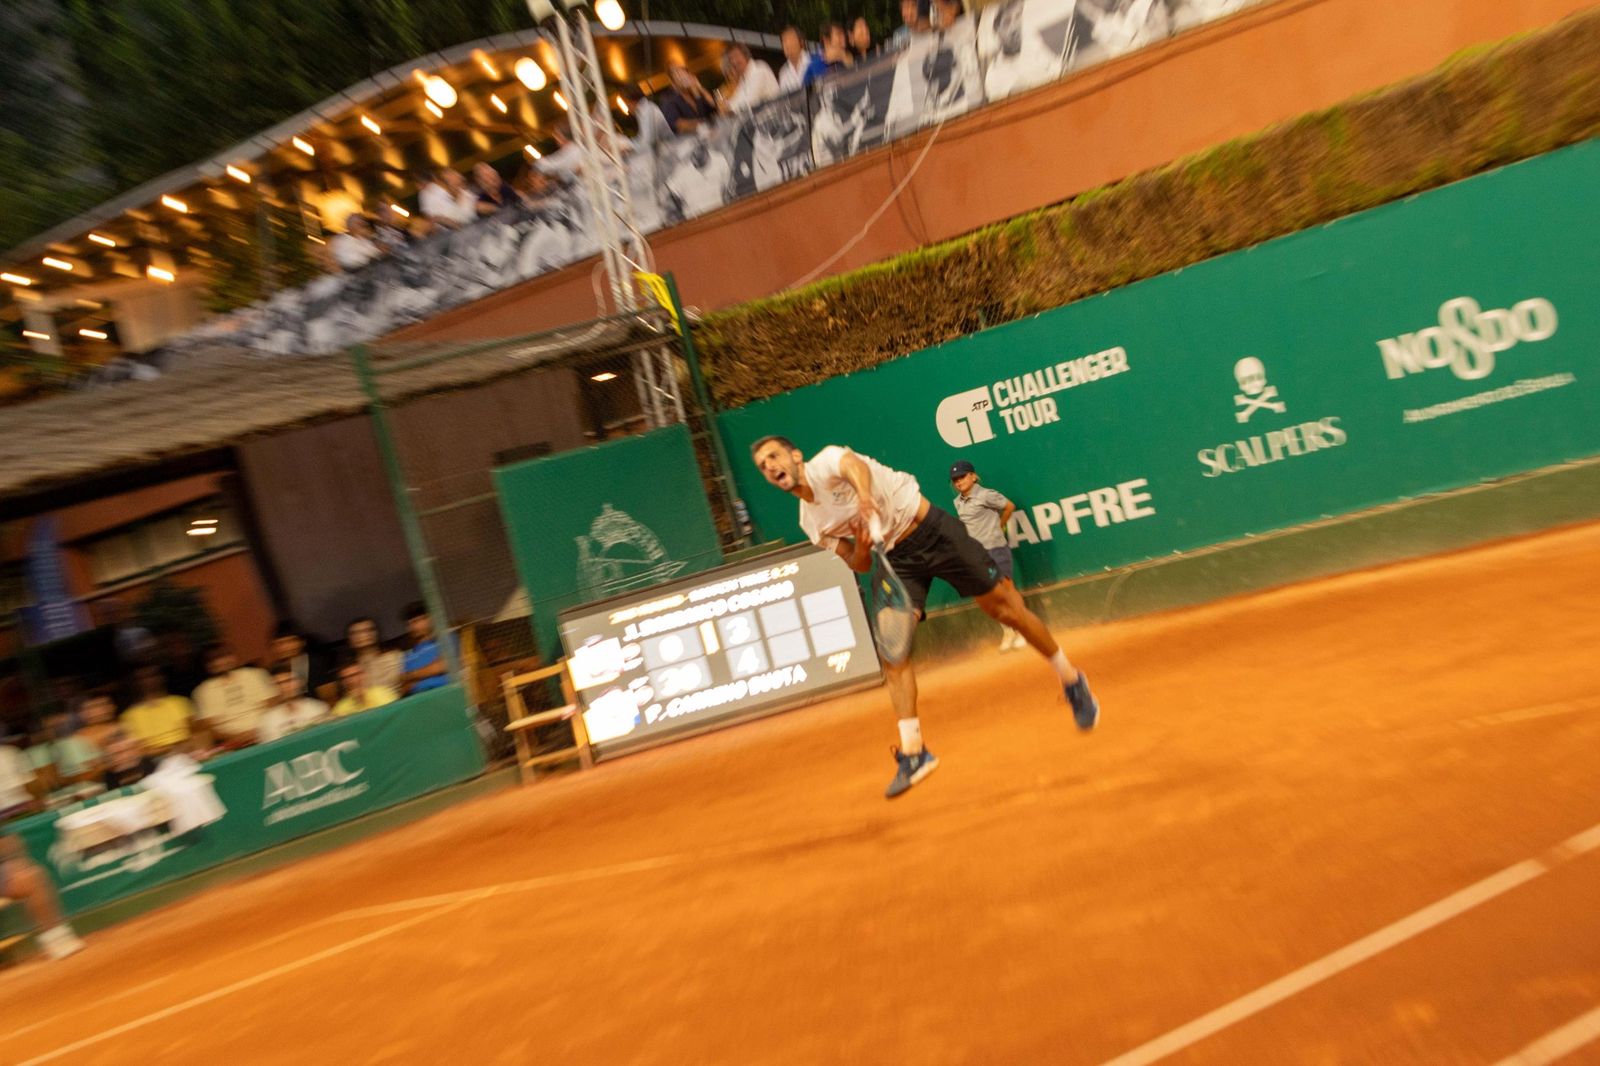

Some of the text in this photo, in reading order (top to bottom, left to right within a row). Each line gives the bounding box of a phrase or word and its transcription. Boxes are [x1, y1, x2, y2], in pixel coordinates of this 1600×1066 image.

[992, 346, 1131, 408] CHALLENGER
[971, 399, 989, 412] ATP
[999, 397, 1060, 434] TOUR
[1197, 416, 1347, 478] SCALPERS
[1006, 478, 1156, 549] APFRE
[726, 616, 751, 645] 3
[736, 646, 760, 674] 4
[261, 738, 366, 811] ABC
